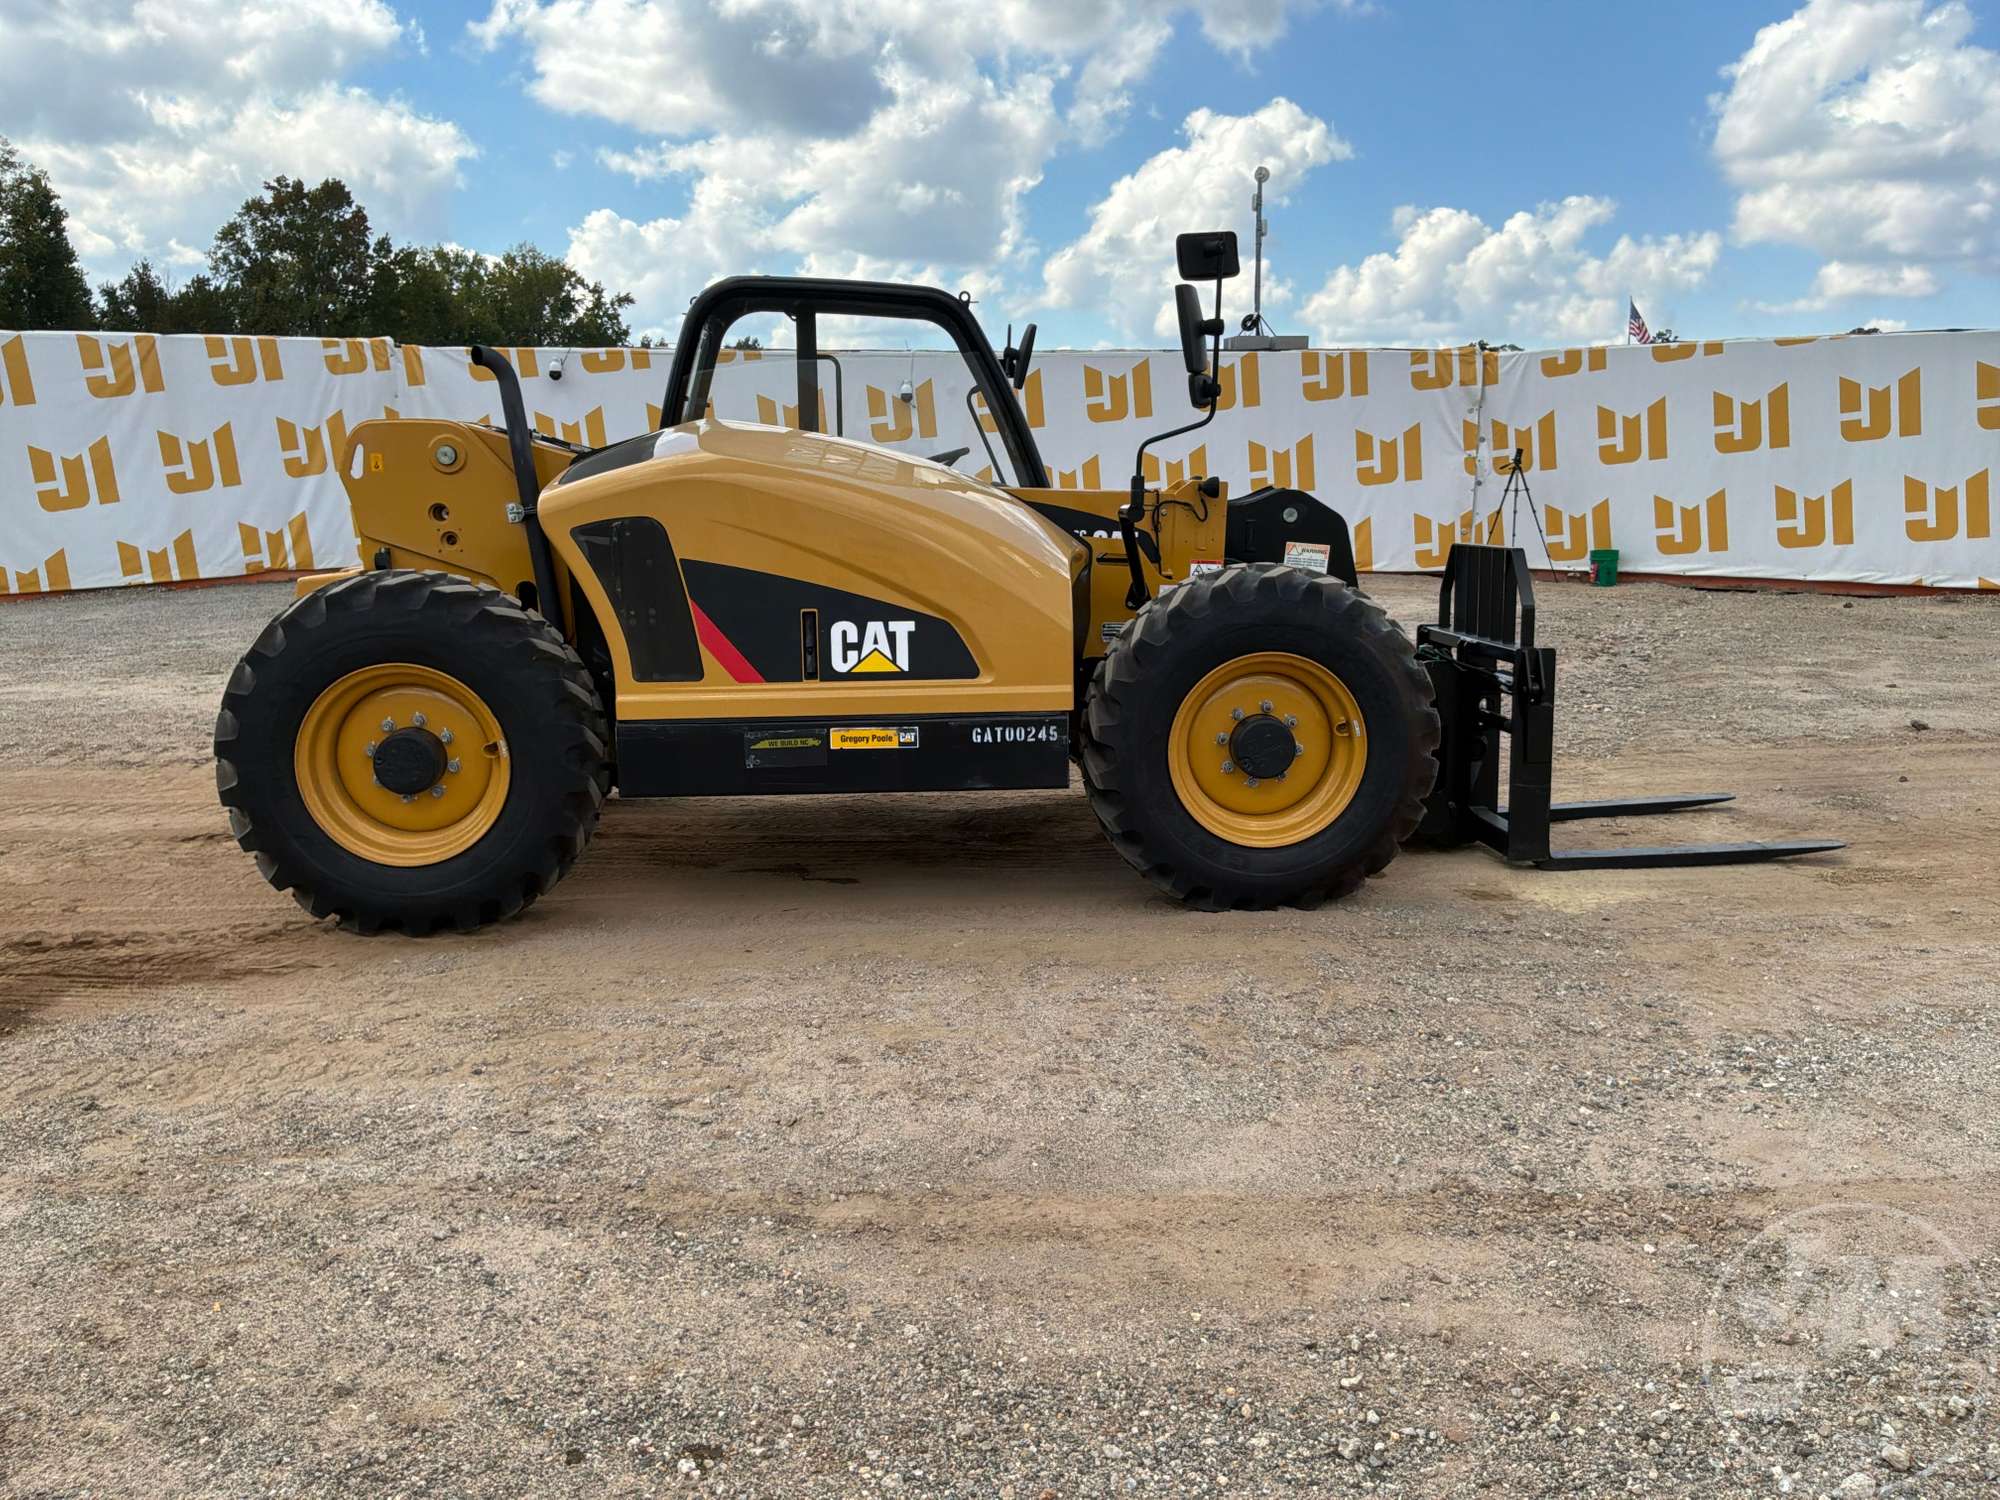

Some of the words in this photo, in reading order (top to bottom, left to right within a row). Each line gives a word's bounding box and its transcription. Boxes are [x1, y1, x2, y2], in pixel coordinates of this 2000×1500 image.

[830, 620, 916, 673] CAT
[840, 734, 869, 744] Gregory
[871, 734, 893, 742] Poole
[899, 732, 916, 743] CAT
